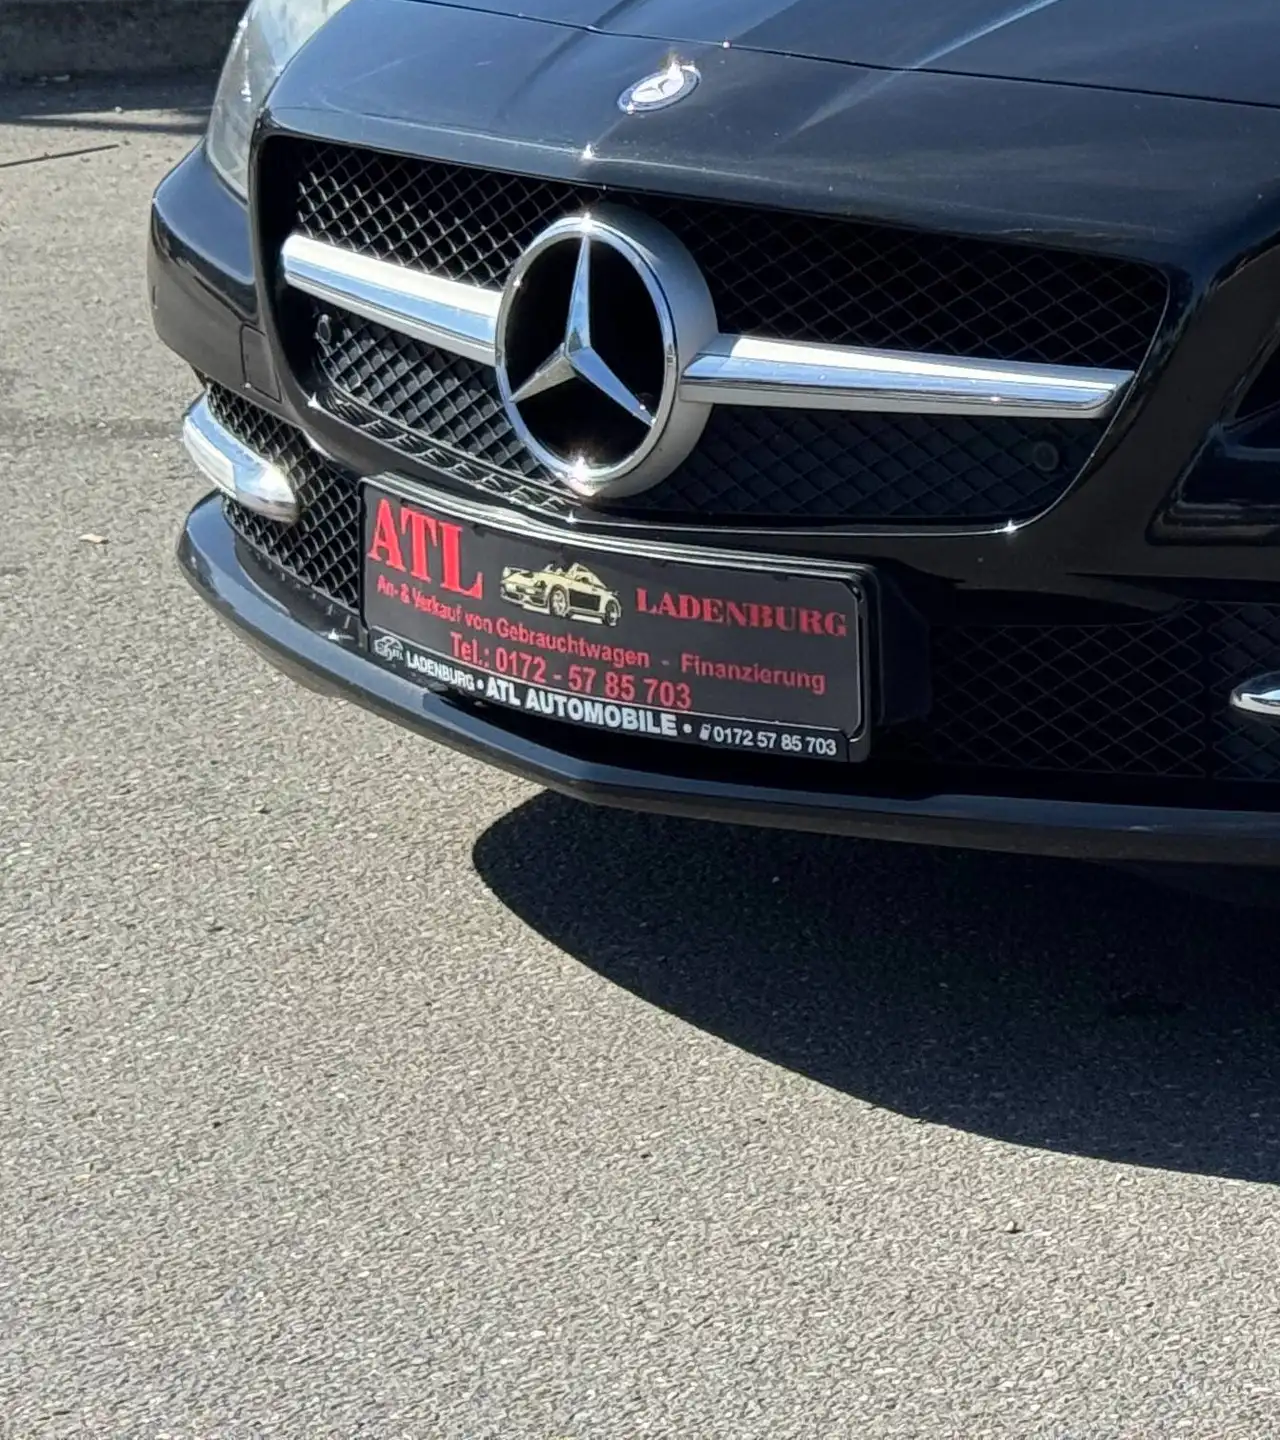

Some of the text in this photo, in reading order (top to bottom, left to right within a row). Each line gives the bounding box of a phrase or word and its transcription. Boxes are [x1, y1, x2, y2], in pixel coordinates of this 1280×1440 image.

[367, 498, 484, 600] ATL
[376, 573, 399, 597] An-
[400, 585, 411, 605] &
[412, 587, 462, 624] Verkauf
[465, 610, 493, 634] von
[496, 616, 650, 669] Gebrauchtwagen
[680, 652, 826, 696] Finanzierung
[635, 587, 848, 637] LADENBURG
[405, 650, 838, 756] LADENBURG ATL AUTOMOBILE 0172 57 85 703
[449, 630, 490, 669] Tel.:
[495, 646, 547, 684] 0172
[568, 664, 597, 694] 57
[604, 671, 636, 702] 85
[643, 678, 692, 711] 703
